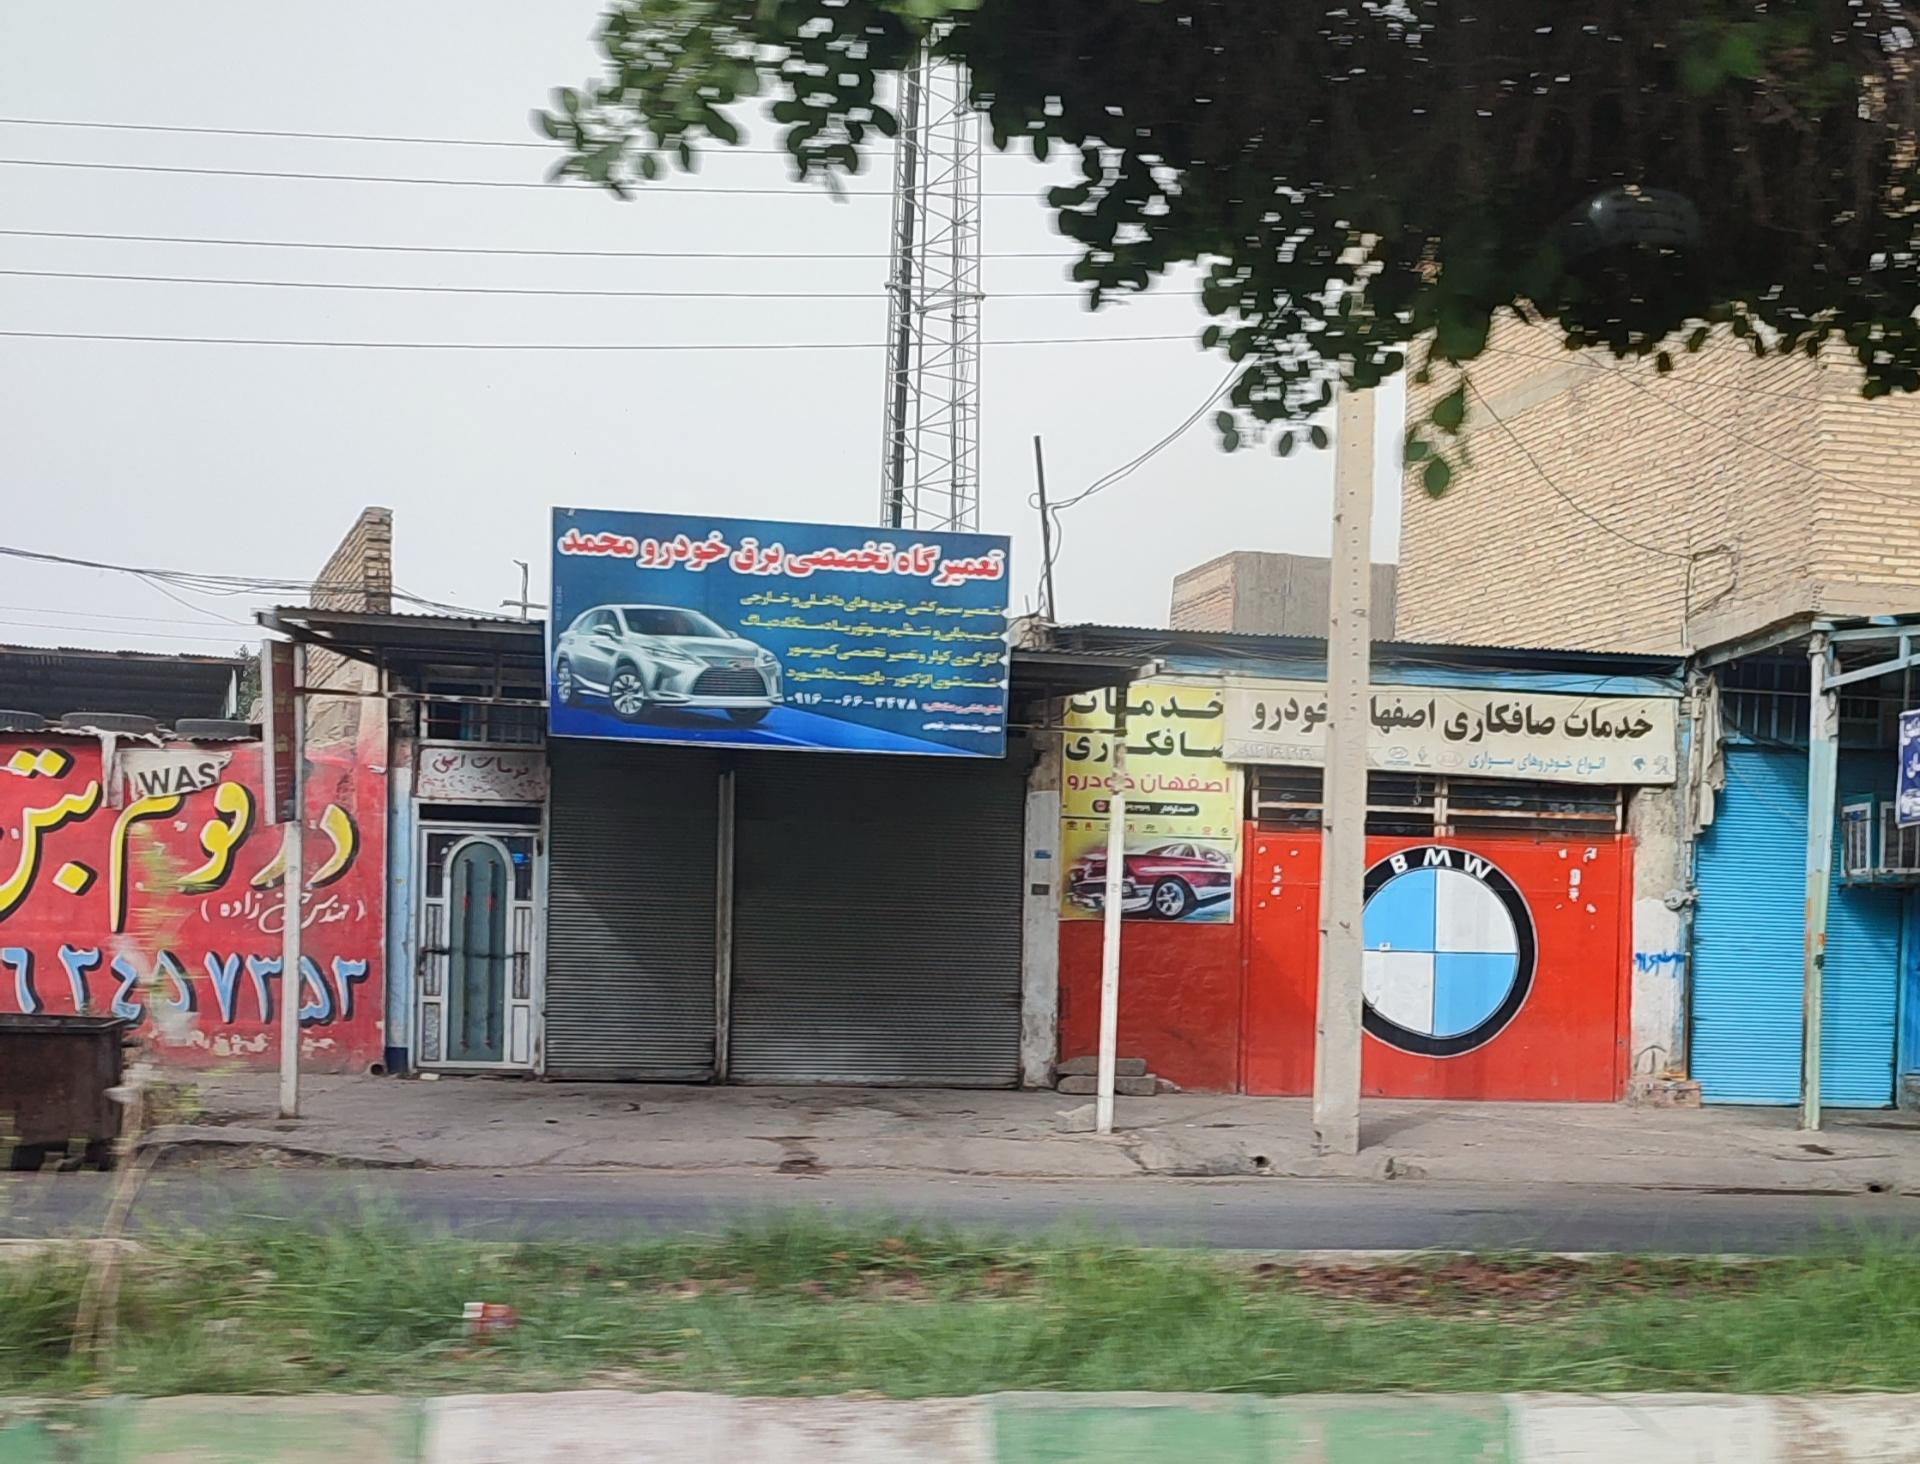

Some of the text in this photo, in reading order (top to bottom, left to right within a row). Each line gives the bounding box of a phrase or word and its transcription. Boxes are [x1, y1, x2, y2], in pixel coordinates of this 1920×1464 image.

[557, 528, 638, 558] محمد
[637, 531, 731, 571] خودرو
[728, 537, 784, 574] برق
[784, 541, 894, 580] تخصصی
[1369, 694, 1436, 735] اصفها
[1444, 701, 1556, 743] صافکاری
[1564, 706, 1654, 739] خدمات
[1065, 727, 1224, 762] افکری
[1468, 751, 1515, 770] سواری
[138, 760, 224, 796] WAS
[1140, 772, 1231, 794] اصفهان
[1389, 849, 1493, 880] BMW
